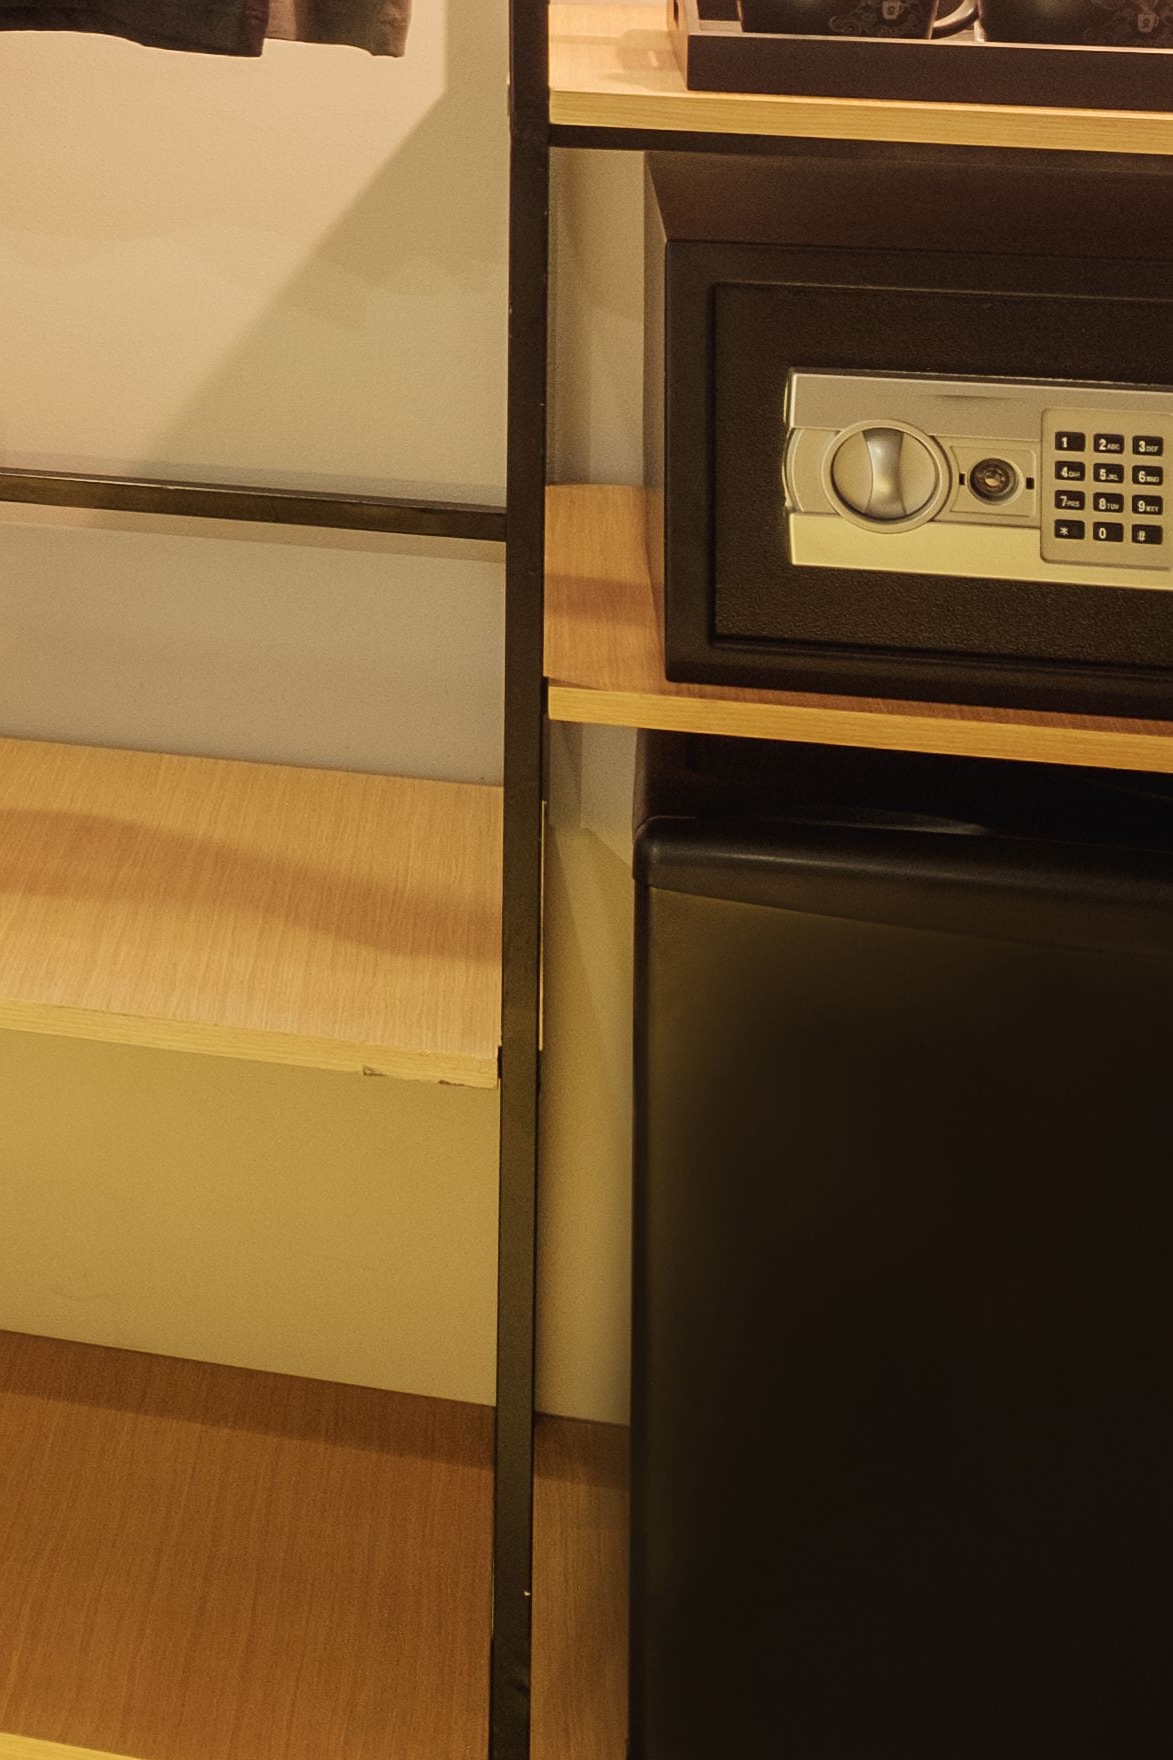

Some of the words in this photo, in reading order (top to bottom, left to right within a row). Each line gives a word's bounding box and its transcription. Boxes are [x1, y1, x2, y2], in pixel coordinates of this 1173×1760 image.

[1061, 436, 1068, 448] 1
[1098, 438, 1107, 451] 2
[1139, 440, 1146, 452] 3
[1061, 466, 1068, 478] 4
[1099, 468, 1106, 480] 5
[1138, 470, 1146, 483] 6
[1059, 495, 1068, 507] 7
[1098, 497, 1106, 510] 8
[1137, 500, 1146, 512] 9
